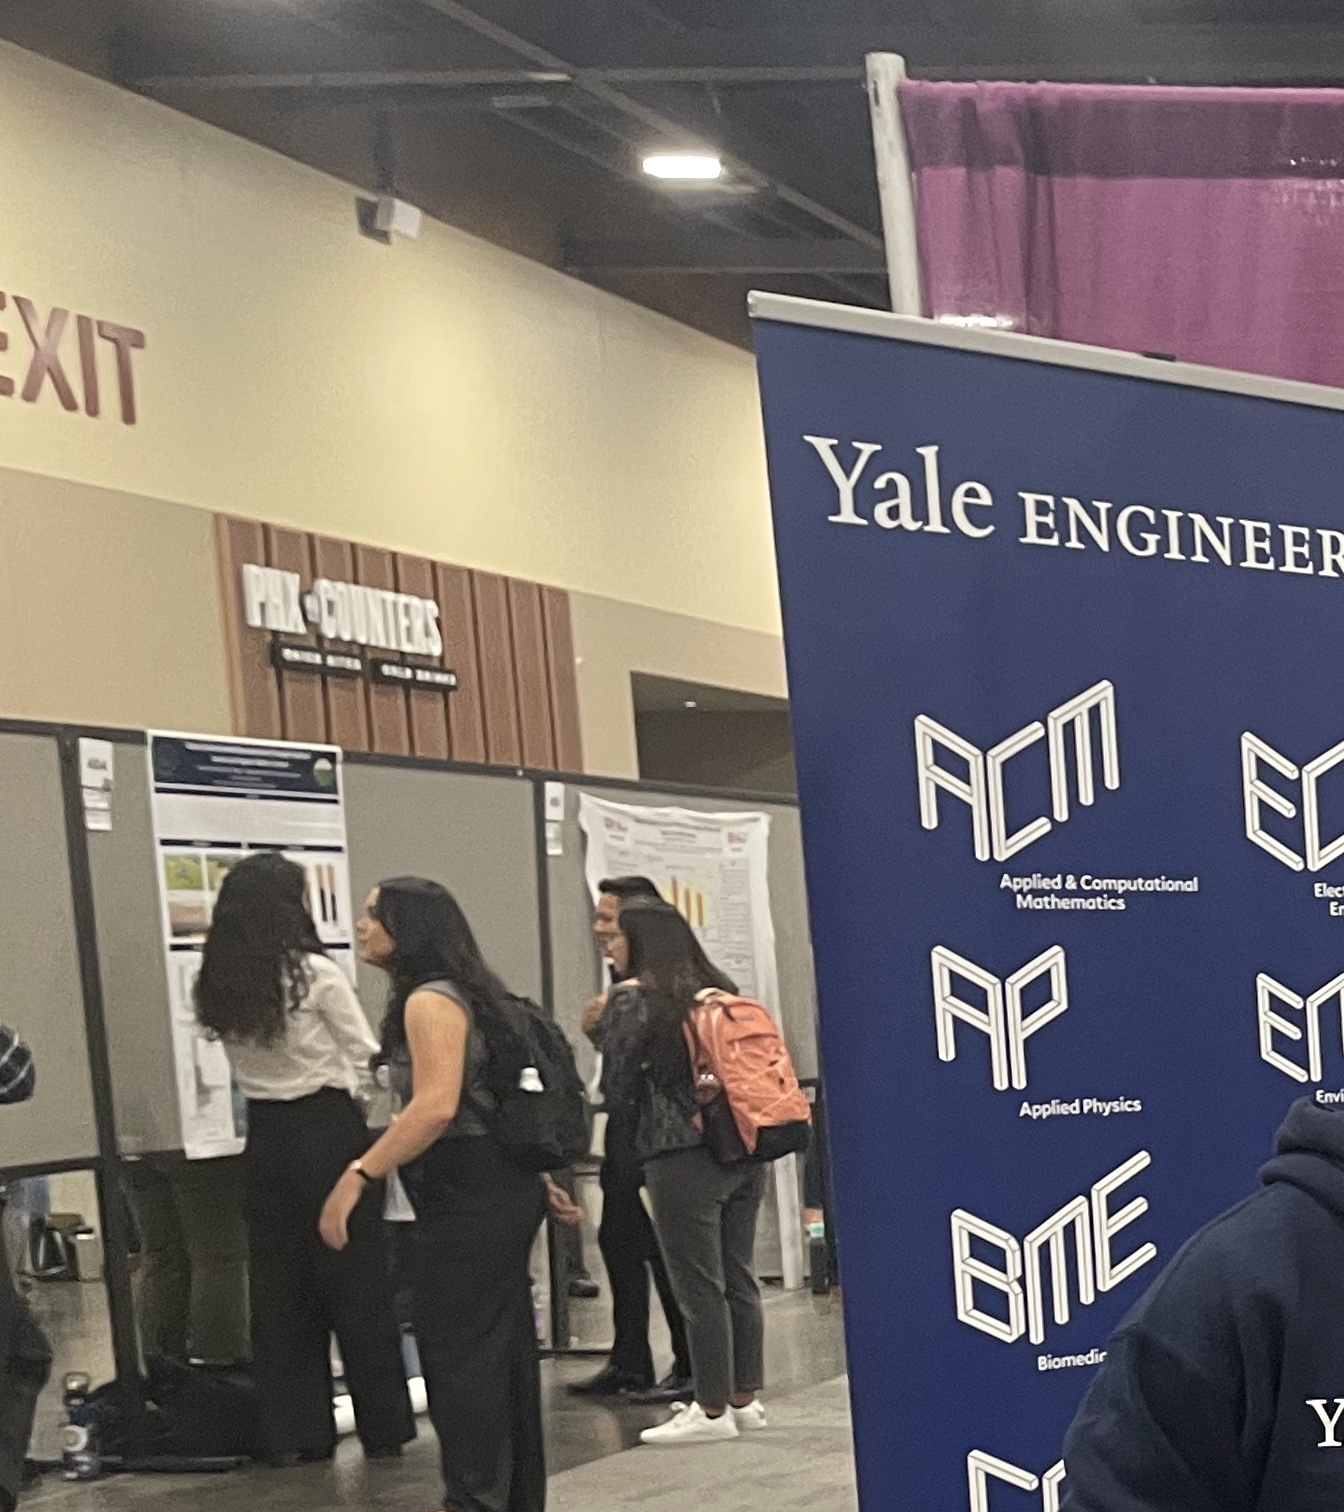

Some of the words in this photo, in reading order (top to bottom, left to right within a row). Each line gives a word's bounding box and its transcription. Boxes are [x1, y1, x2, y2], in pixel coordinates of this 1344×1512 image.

[0, 291, 144, 425] XIT
[803, 435, 995, 539] Yale
[914, 680, 1120, 862] ACM
[1000, 873, 1062, 896] Applied
[1064, 874, 1078, 891] &
[1080, 874, 1200, 896] Computational
[1016, 894, 1127, 912] Mathematics
[931, 945, 1069, 1091] AP
[1019, 1099, 1081, 1121] Applied
[1083, 1097, 1142, 1118] Physics
[951, 1150, 1157, 1345] BME
